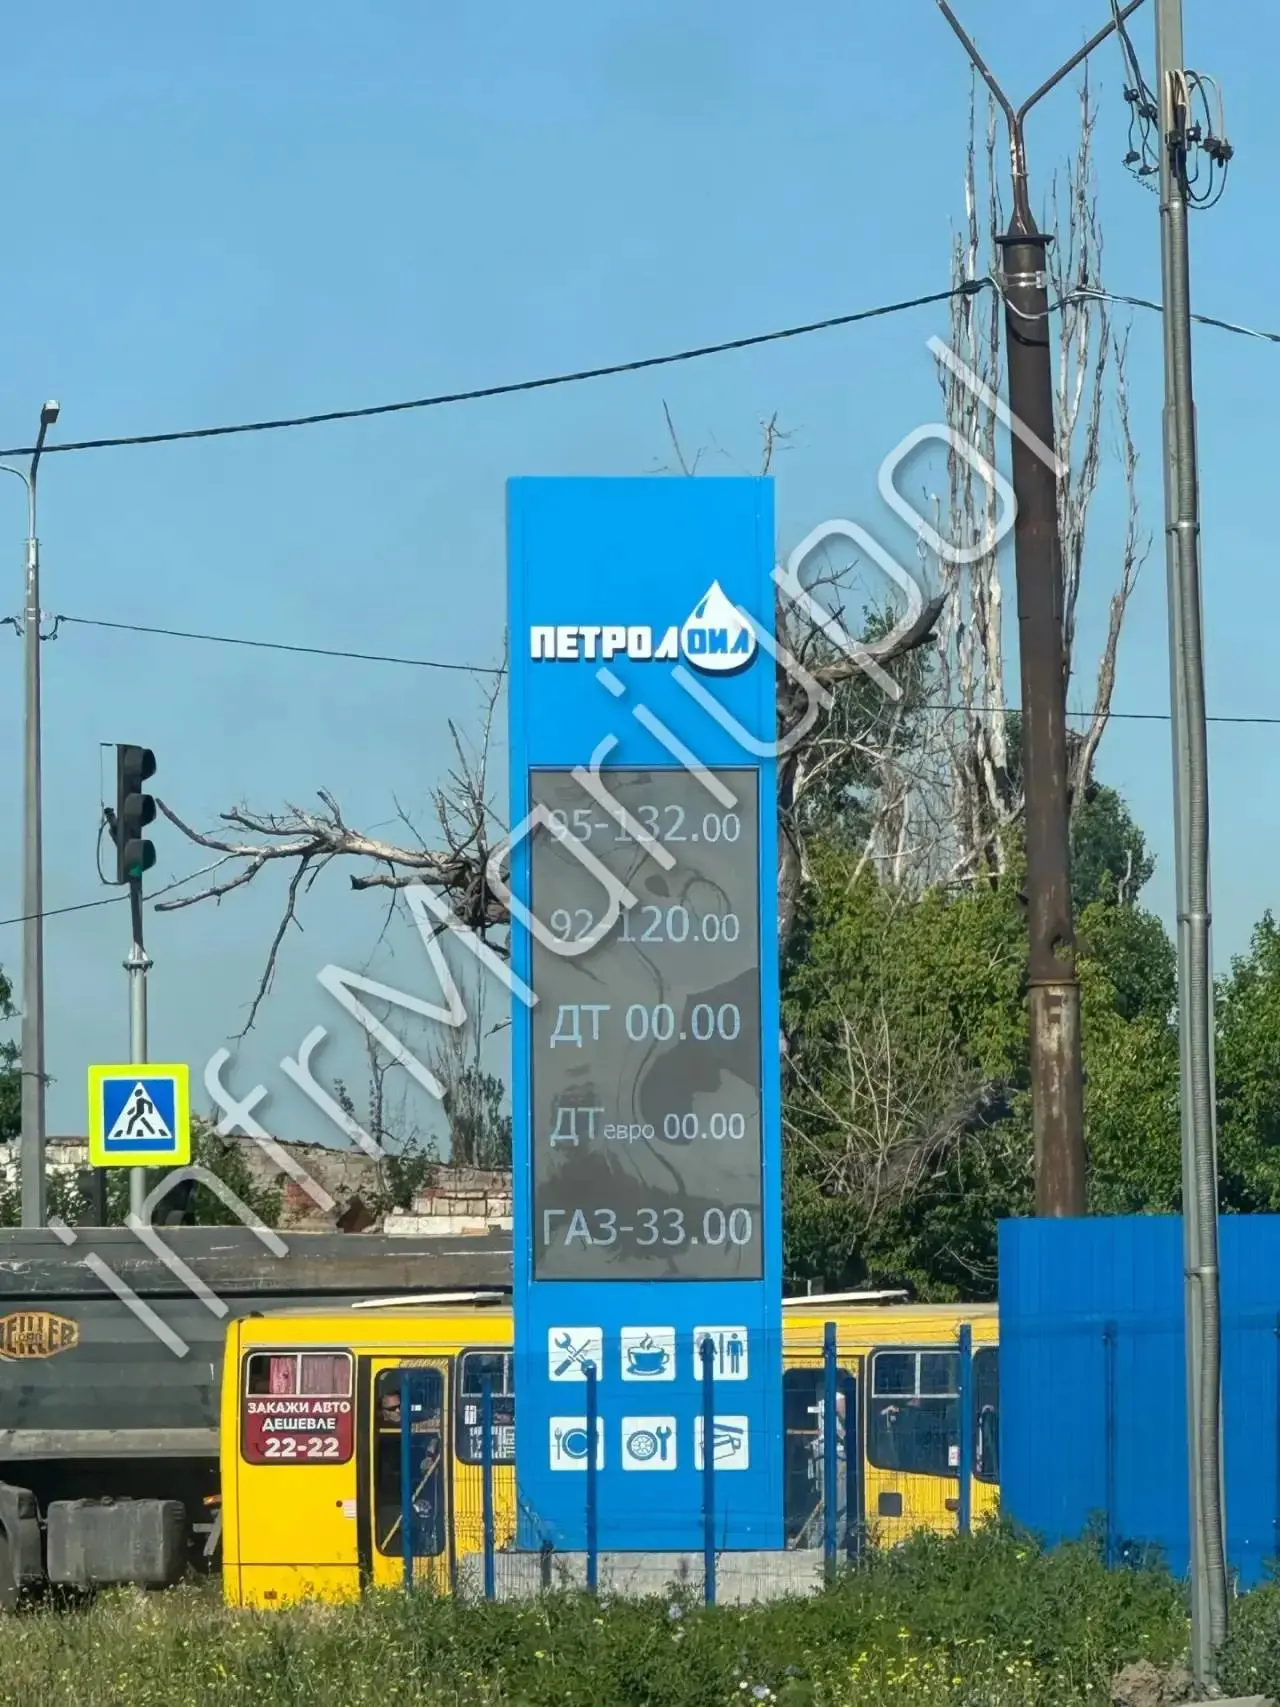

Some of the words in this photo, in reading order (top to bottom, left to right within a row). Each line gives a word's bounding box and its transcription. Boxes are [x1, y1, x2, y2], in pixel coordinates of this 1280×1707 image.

[530, 626, 678, 658] ПЕТРОЛ
[687, 628, 749, 654] ОИЛ
[550, 1004, 610, 1048] ДТ
[625, 1003, 740, 1041] 00.00
[663, 1112, 745, 1140] 00.00
[247, 1401, 309, 1414] ЗАКАЖИ
[312, 1401, 351, 1414] АВТО
[262, 1417, 337, 1432] ДЕШЕВЛЕ
[264, 1437, 340, 1457] 22-22
